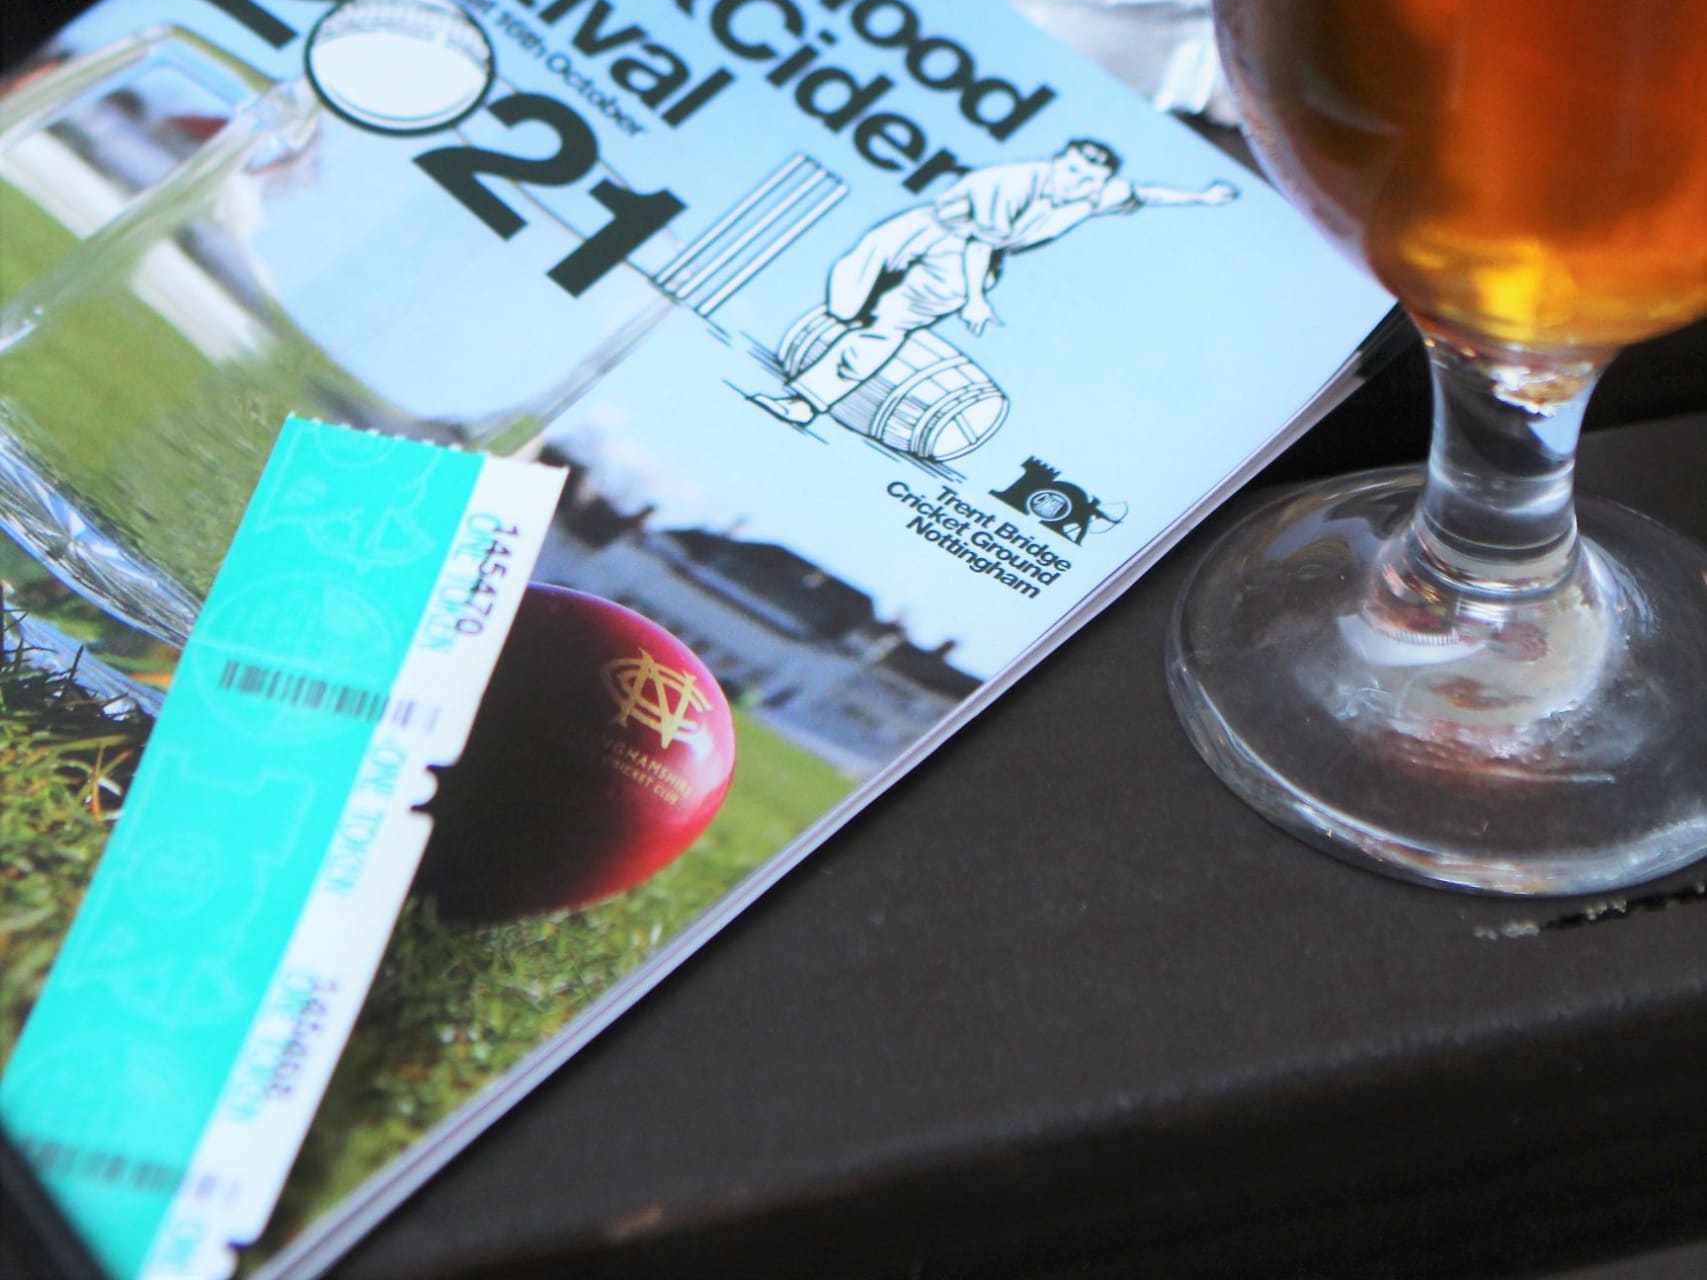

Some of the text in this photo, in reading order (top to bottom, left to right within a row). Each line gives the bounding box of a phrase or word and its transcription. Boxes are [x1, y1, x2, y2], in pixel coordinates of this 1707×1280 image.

[546, 54, 648, 137] October
[886, 481, 1060, 587] Cricket Ground
[905, 515, 1041, 600] Nottingham
[935, 485, 1072, 573] Trent Bridge
[455, 524, 520, 636] 145470
